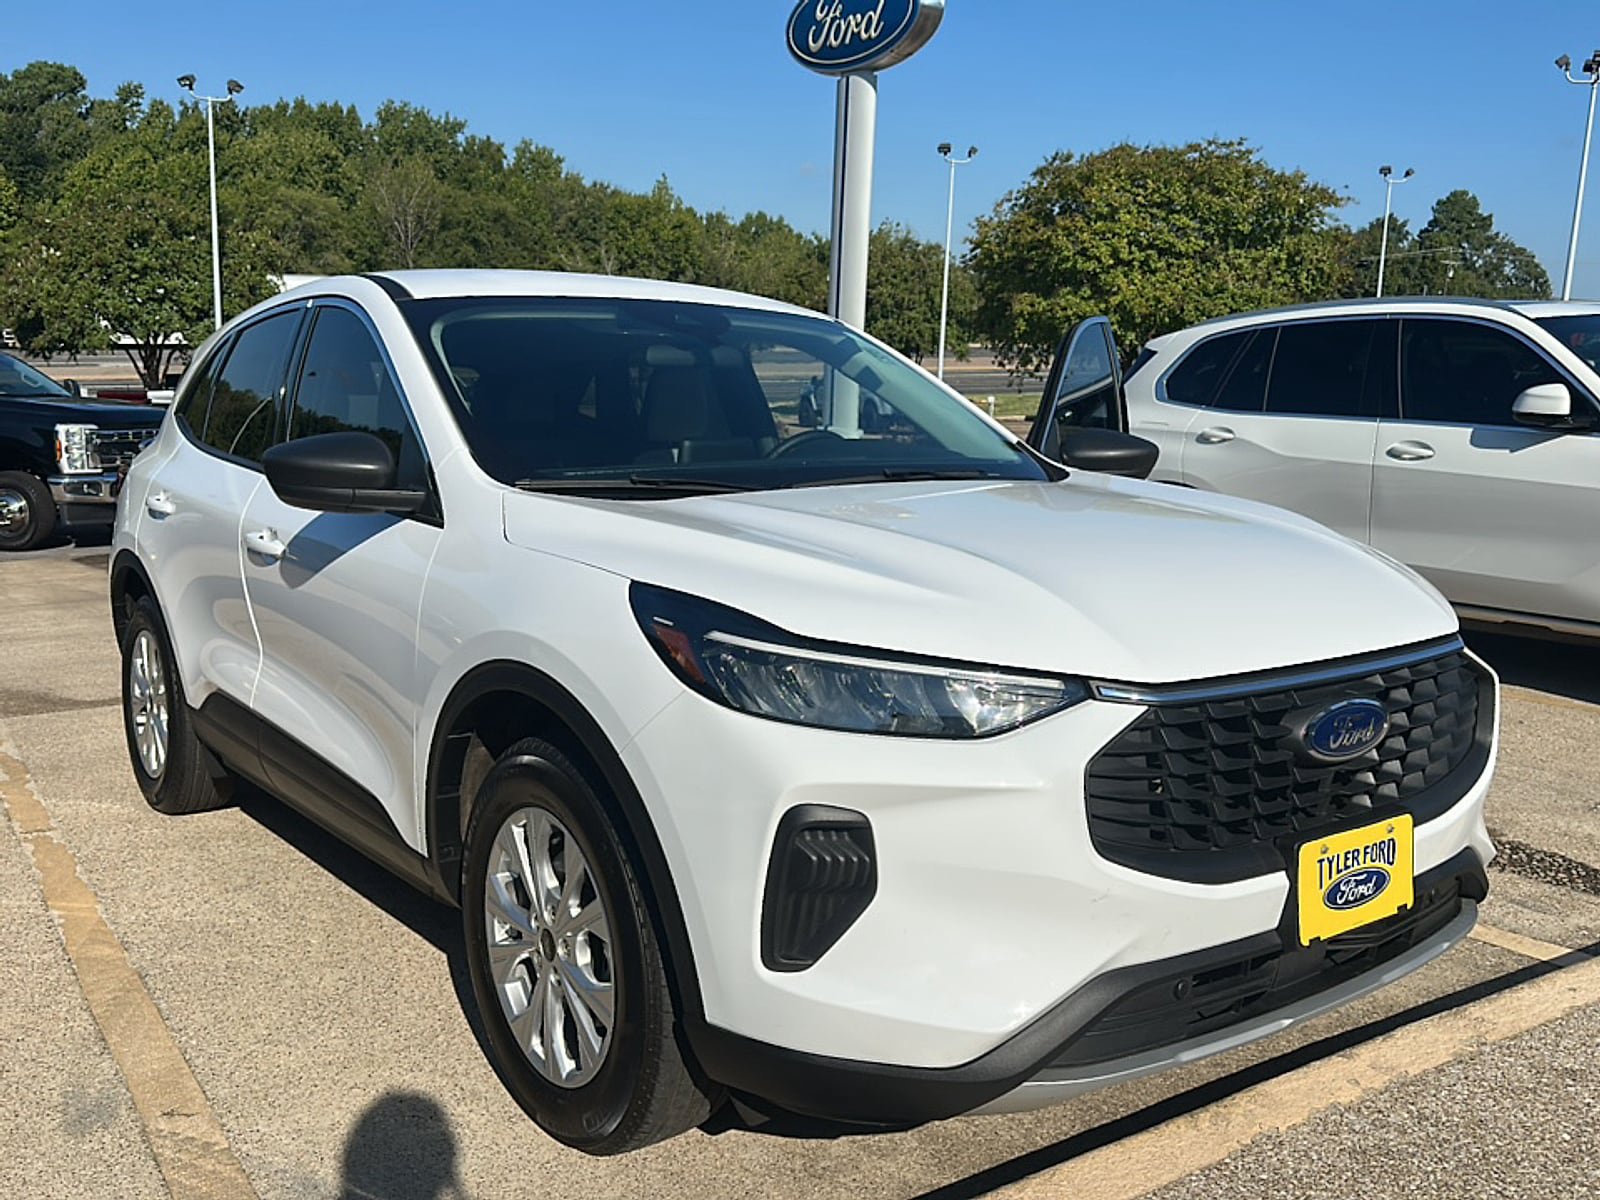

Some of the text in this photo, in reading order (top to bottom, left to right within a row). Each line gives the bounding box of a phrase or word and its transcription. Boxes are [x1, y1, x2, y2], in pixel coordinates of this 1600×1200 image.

[808, 0, 884, 53] Ford
[1329, 714, 1375, 749] Ford
[1317, 838, 1396, 890] TYLER FORD
[1336, 873, 1378, 905] Ford
